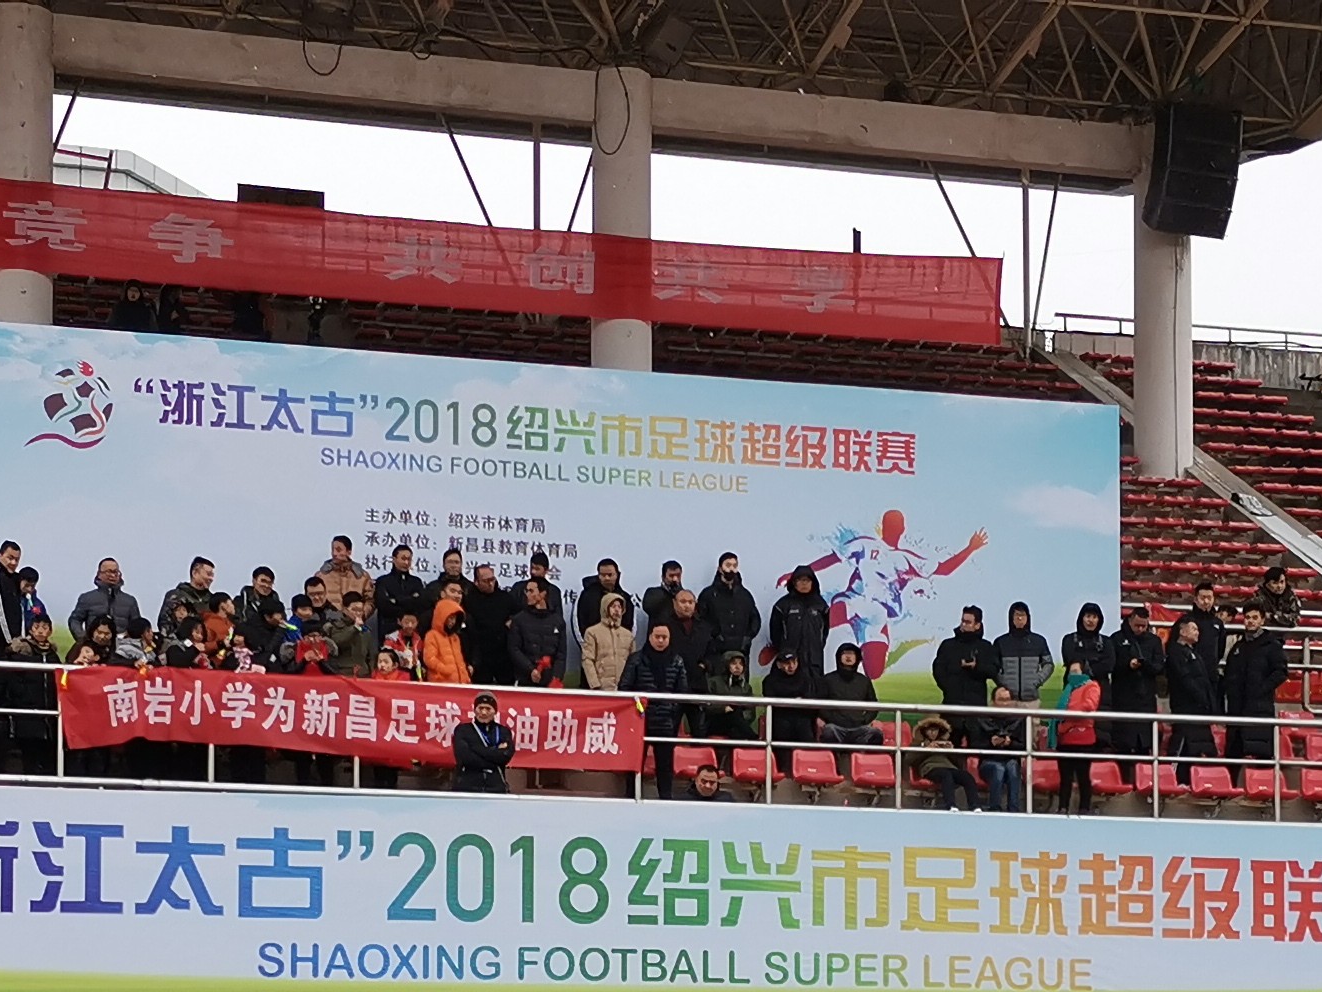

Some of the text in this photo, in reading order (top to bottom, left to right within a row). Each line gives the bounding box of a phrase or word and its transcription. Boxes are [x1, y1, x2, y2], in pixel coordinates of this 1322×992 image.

[133, 377, 917, 476] “浙江太古”2018绍兴市足球超级联赛
[320, 447, 749, 493] SHAOXING FOOTBALL SUPER LEAGUE
[102, 677, 621, 757] 南岩小学为新昌足球油助威
[257, 942, 1094, 992] SHAOXING FOOTBALL SUPER LEAGUE
